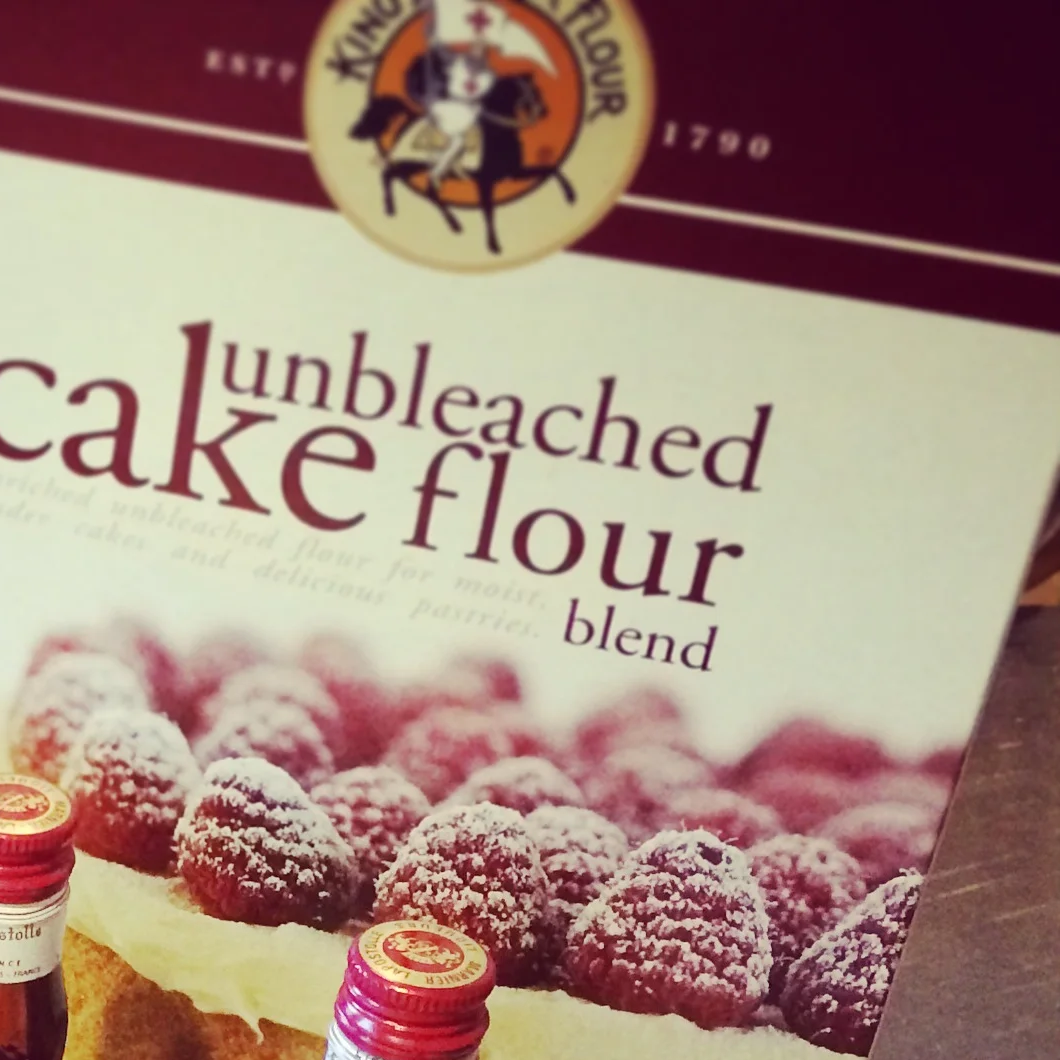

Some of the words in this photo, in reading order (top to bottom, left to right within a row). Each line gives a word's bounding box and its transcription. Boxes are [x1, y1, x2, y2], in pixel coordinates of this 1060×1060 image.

[662, 121, 772, 159] 1790
[222, 330, 774, 493] unbleached
[110, 499, 280, 550] unbleached
[287, 536, 373, 571] flour
[383, 555, 436, 584] for
[401, 441, 745, 607] flour
[73, 521, 147, 551] cakes
[170, 544, 233, 570] and
[252, 558, 387, 607] delicious
[408, 597, 540, 639] pastries.
[563, 598, 719, 672] blend
